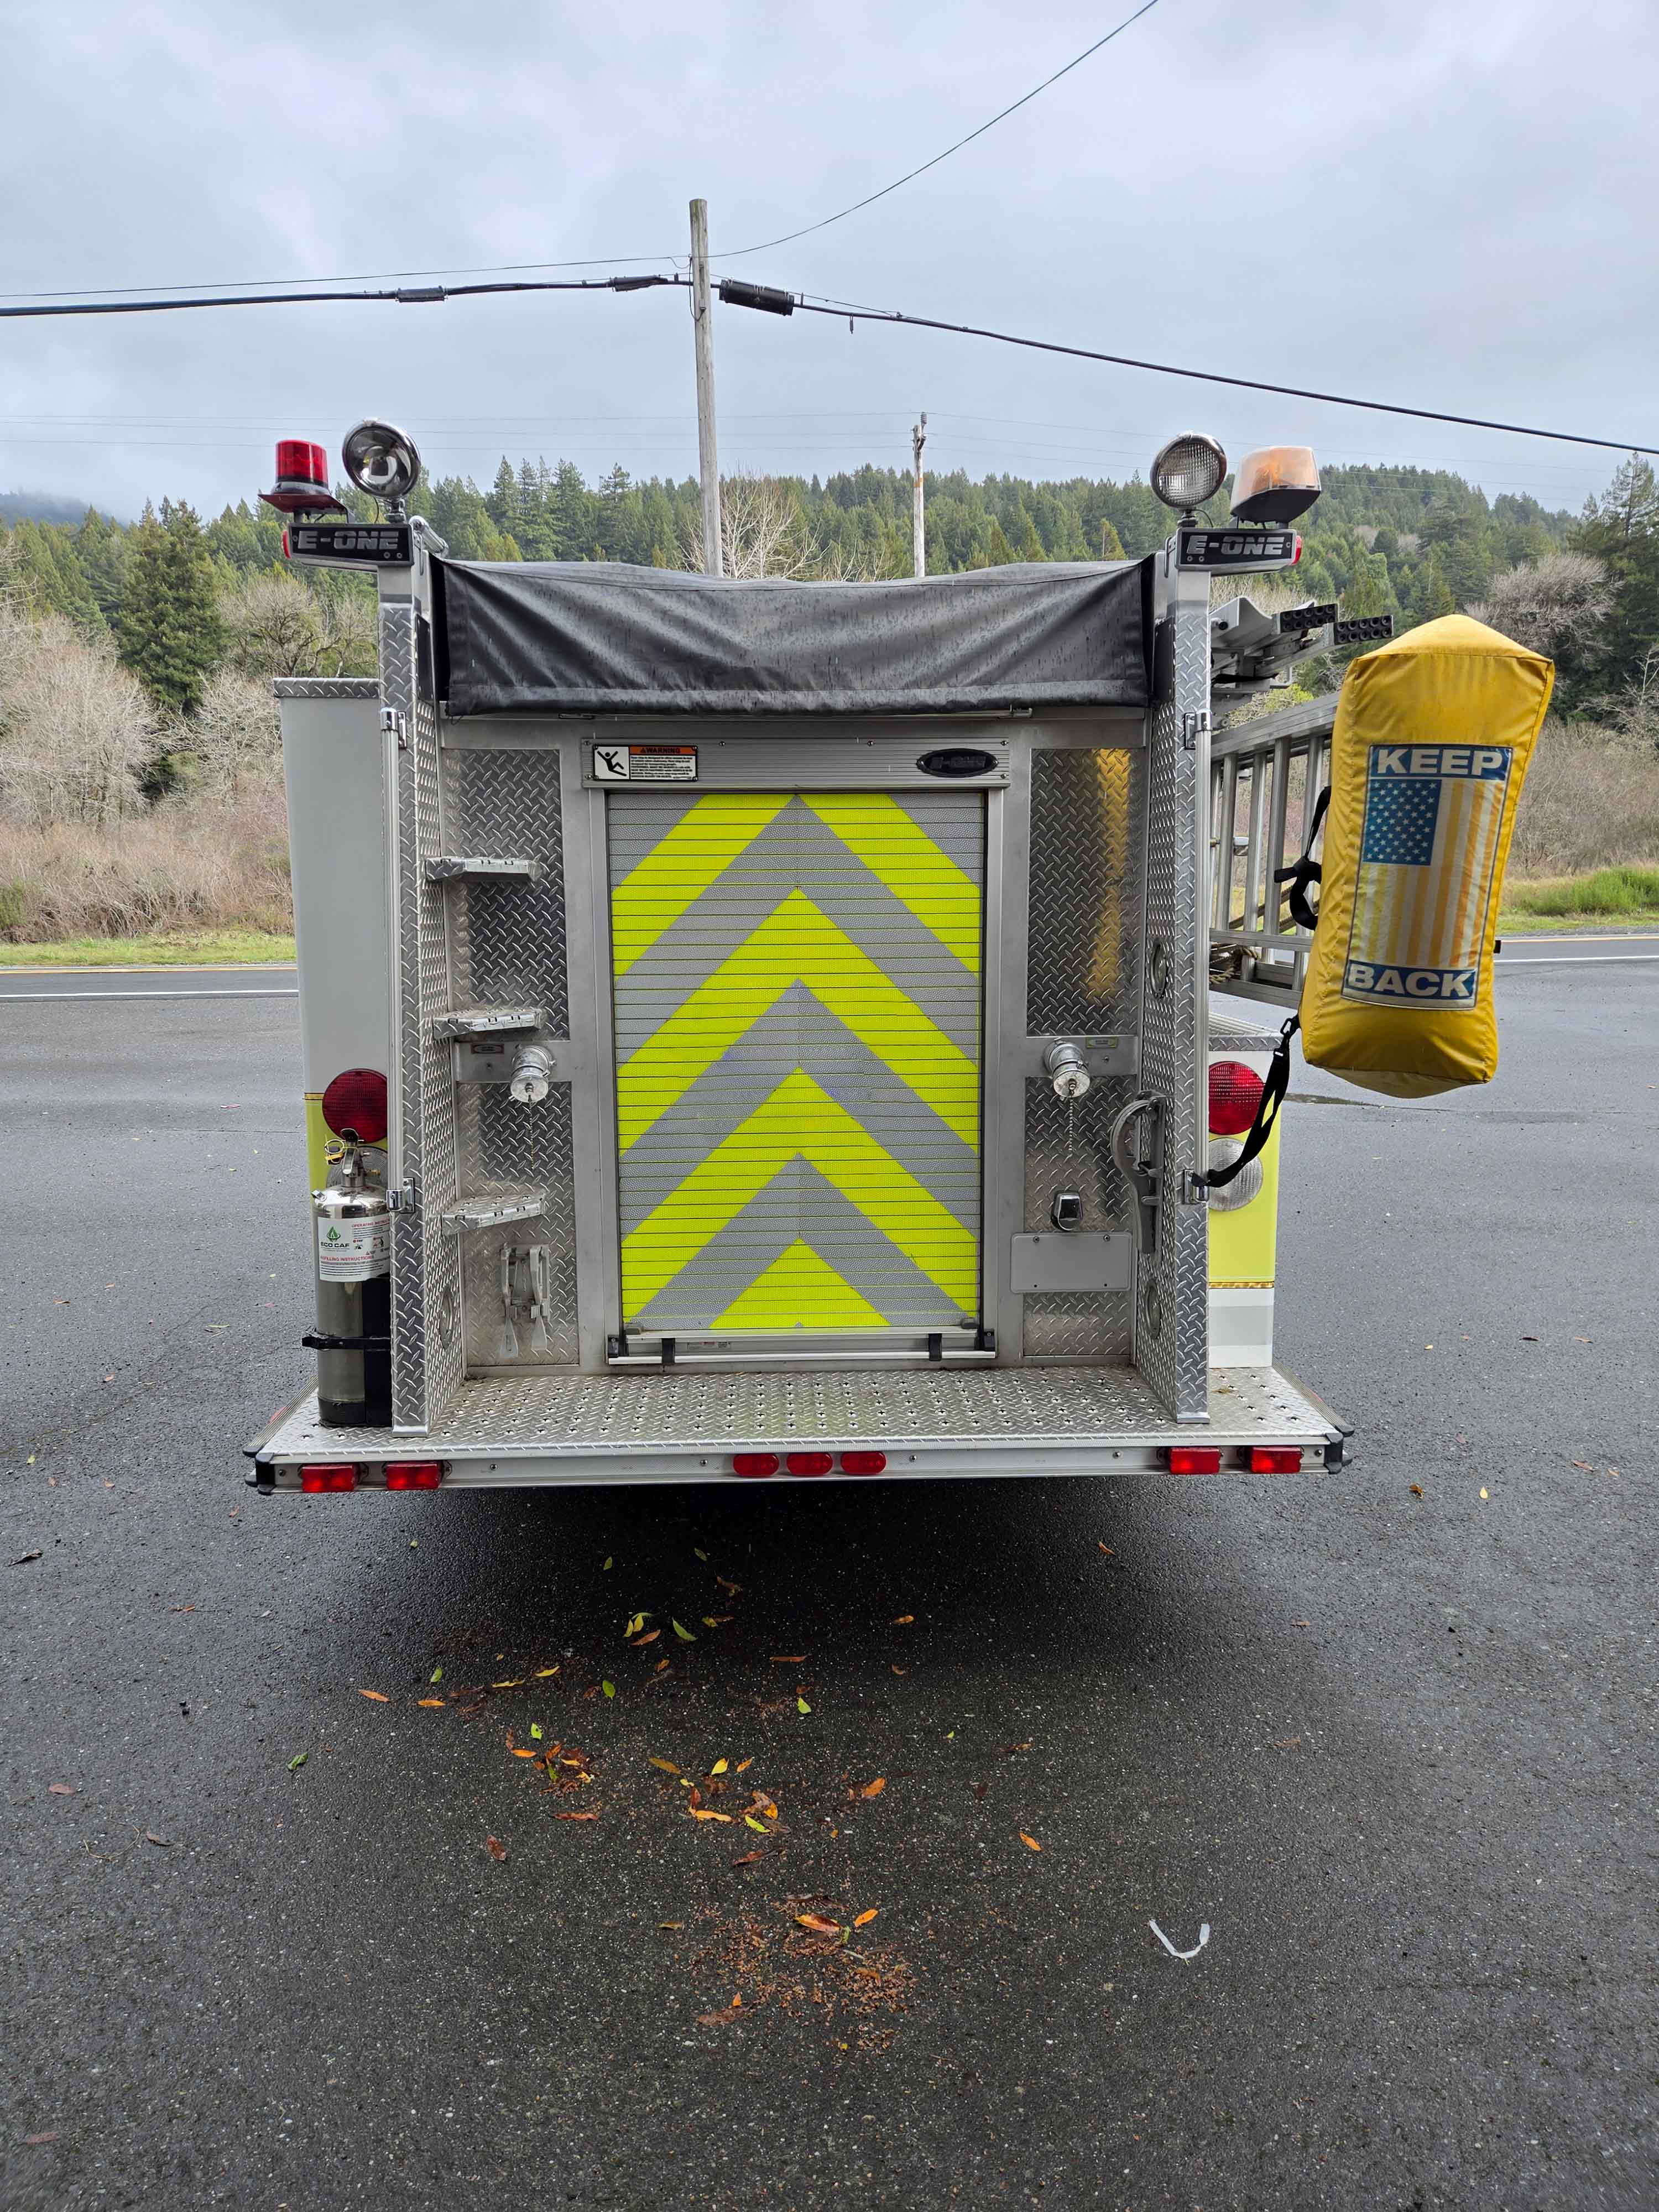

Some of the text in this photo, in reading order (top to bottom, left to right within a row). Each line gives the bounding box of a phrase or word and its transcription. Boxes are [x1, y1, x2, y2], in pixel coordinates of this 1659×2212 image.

[298, 530, 399, 549] E-ONE
[1186, 535, 1285, 555] E-ONE
[1377, 749, 1503, 776] KEEP
[1348, 963, 1472, 997] BACK
